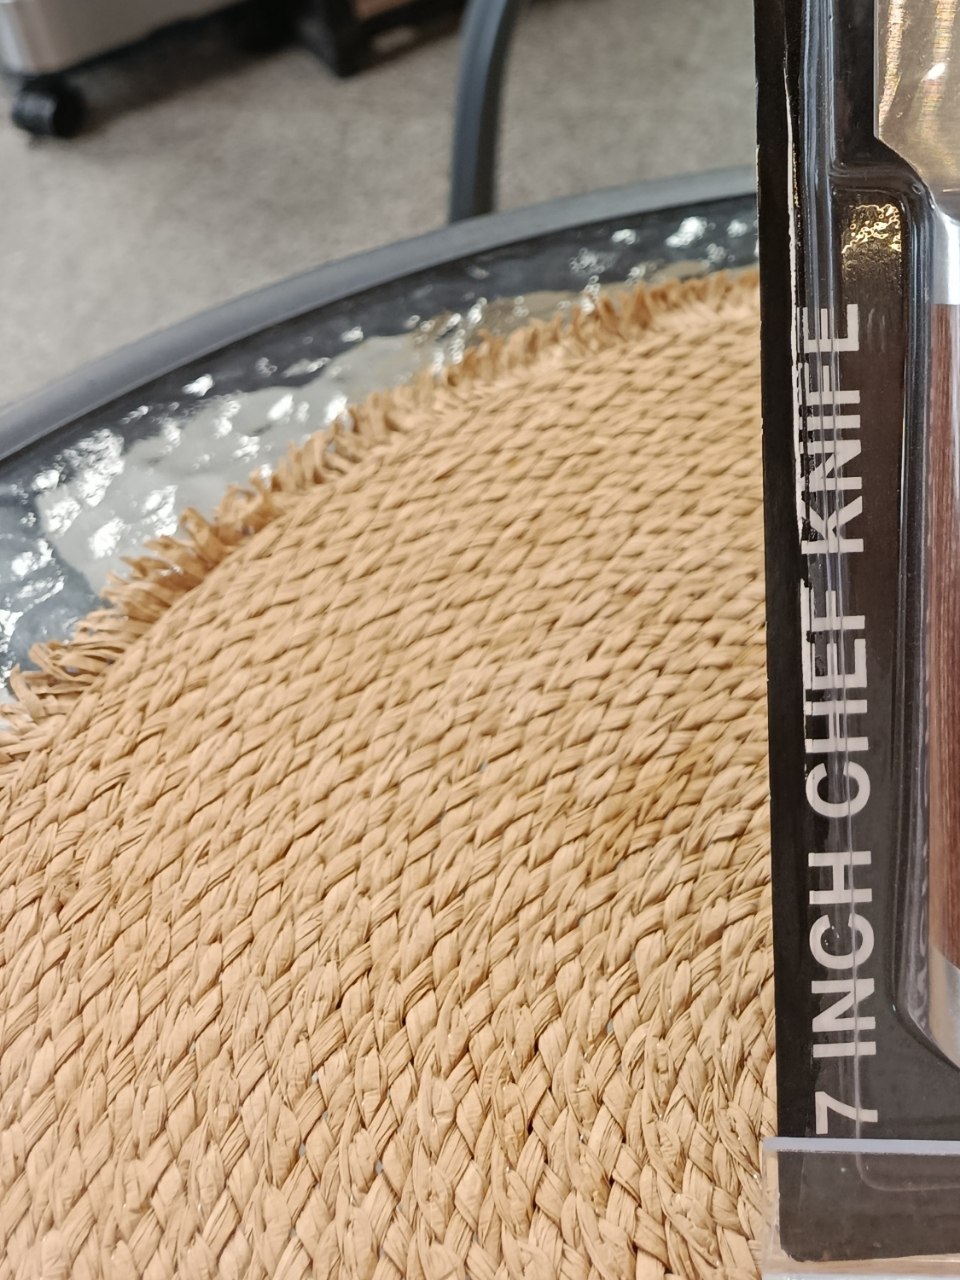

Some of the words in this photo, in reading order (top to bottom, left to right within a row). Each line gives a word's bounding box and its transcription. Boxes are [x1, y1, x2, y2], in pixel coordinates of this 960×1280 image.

[796, 303, 865, 555] KNIFE
[800, 579, 872, 818] CHEF
[807, 850, 877, 1058] INCH
[814, 1091, 879, 1135] 7
